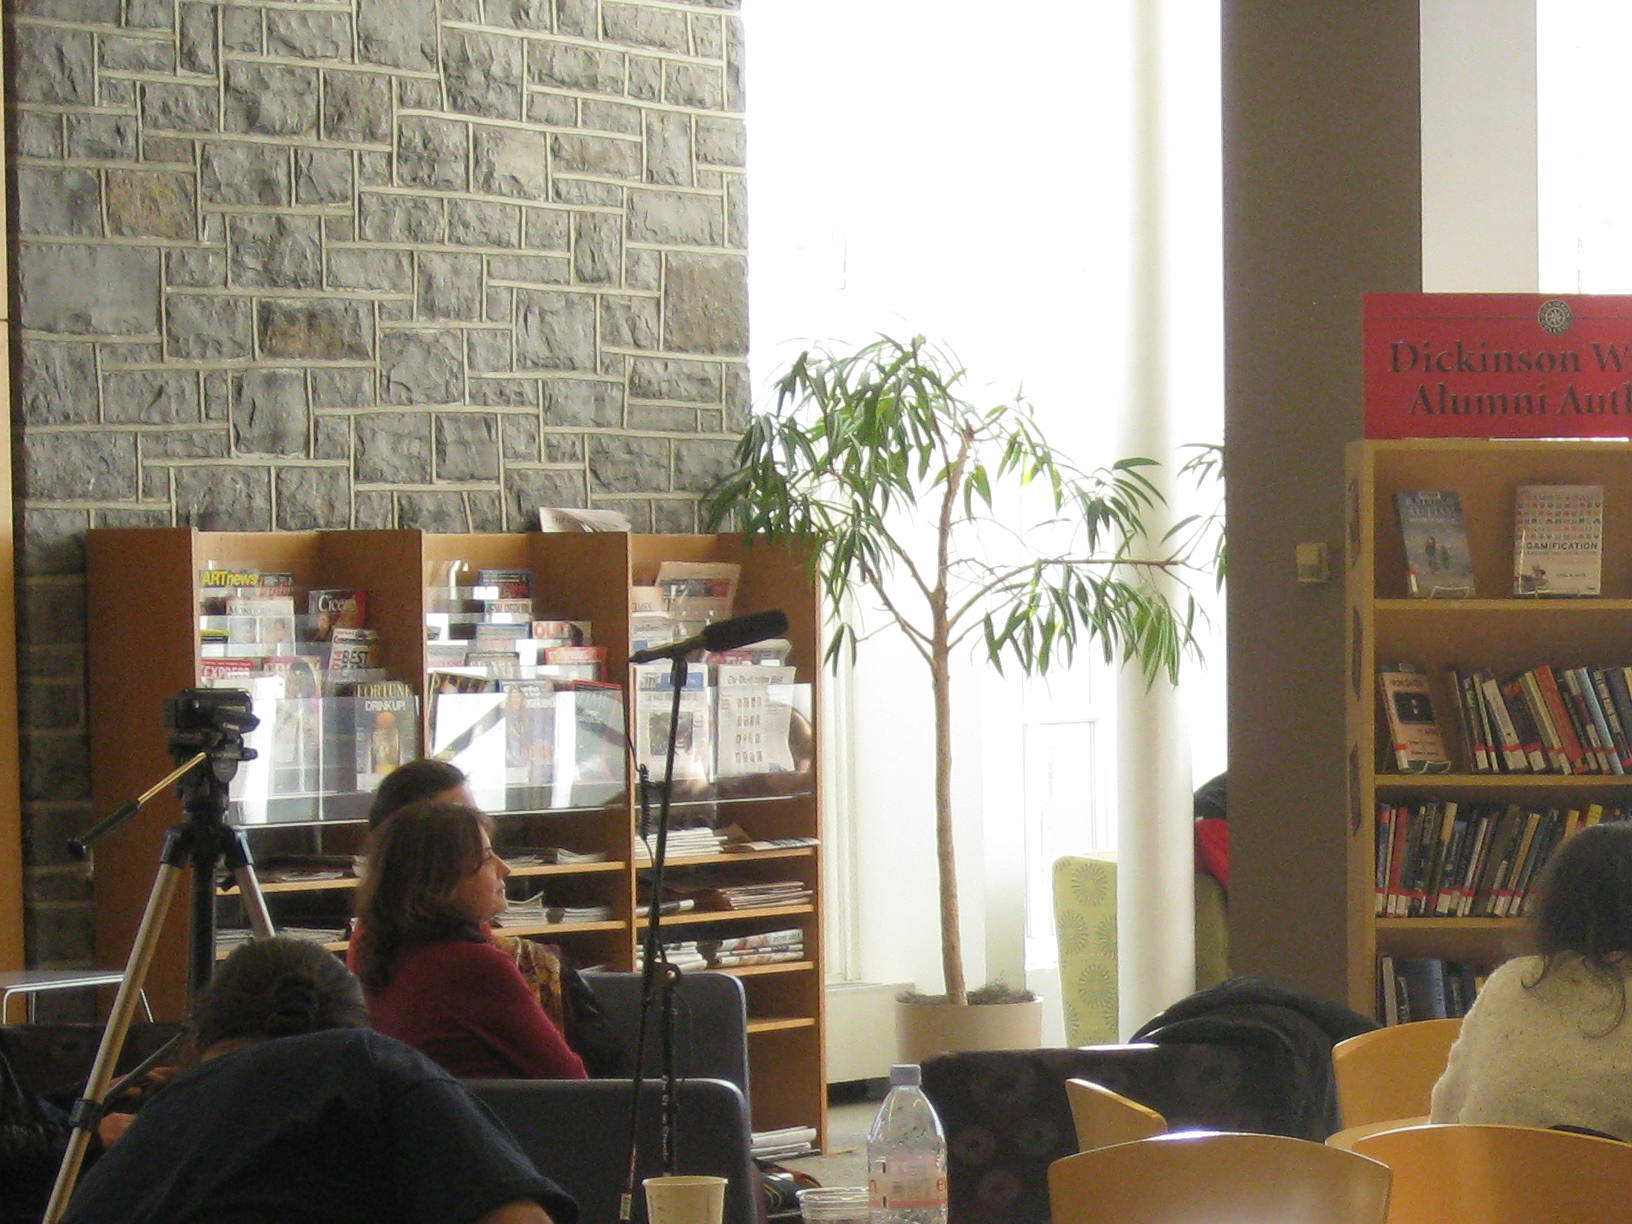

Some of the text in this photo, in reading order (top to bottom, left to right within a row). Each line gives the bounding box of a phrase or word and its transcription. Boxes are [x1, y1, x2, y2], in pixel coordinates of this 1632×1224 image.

[1389, 341, 1581, 373] Dickinson
[1409, 383, 1546, 416] Alumni
[1526, 542, 1598, 550] GAMIFICATION
[202, 570, 259, 586] ARTnews
